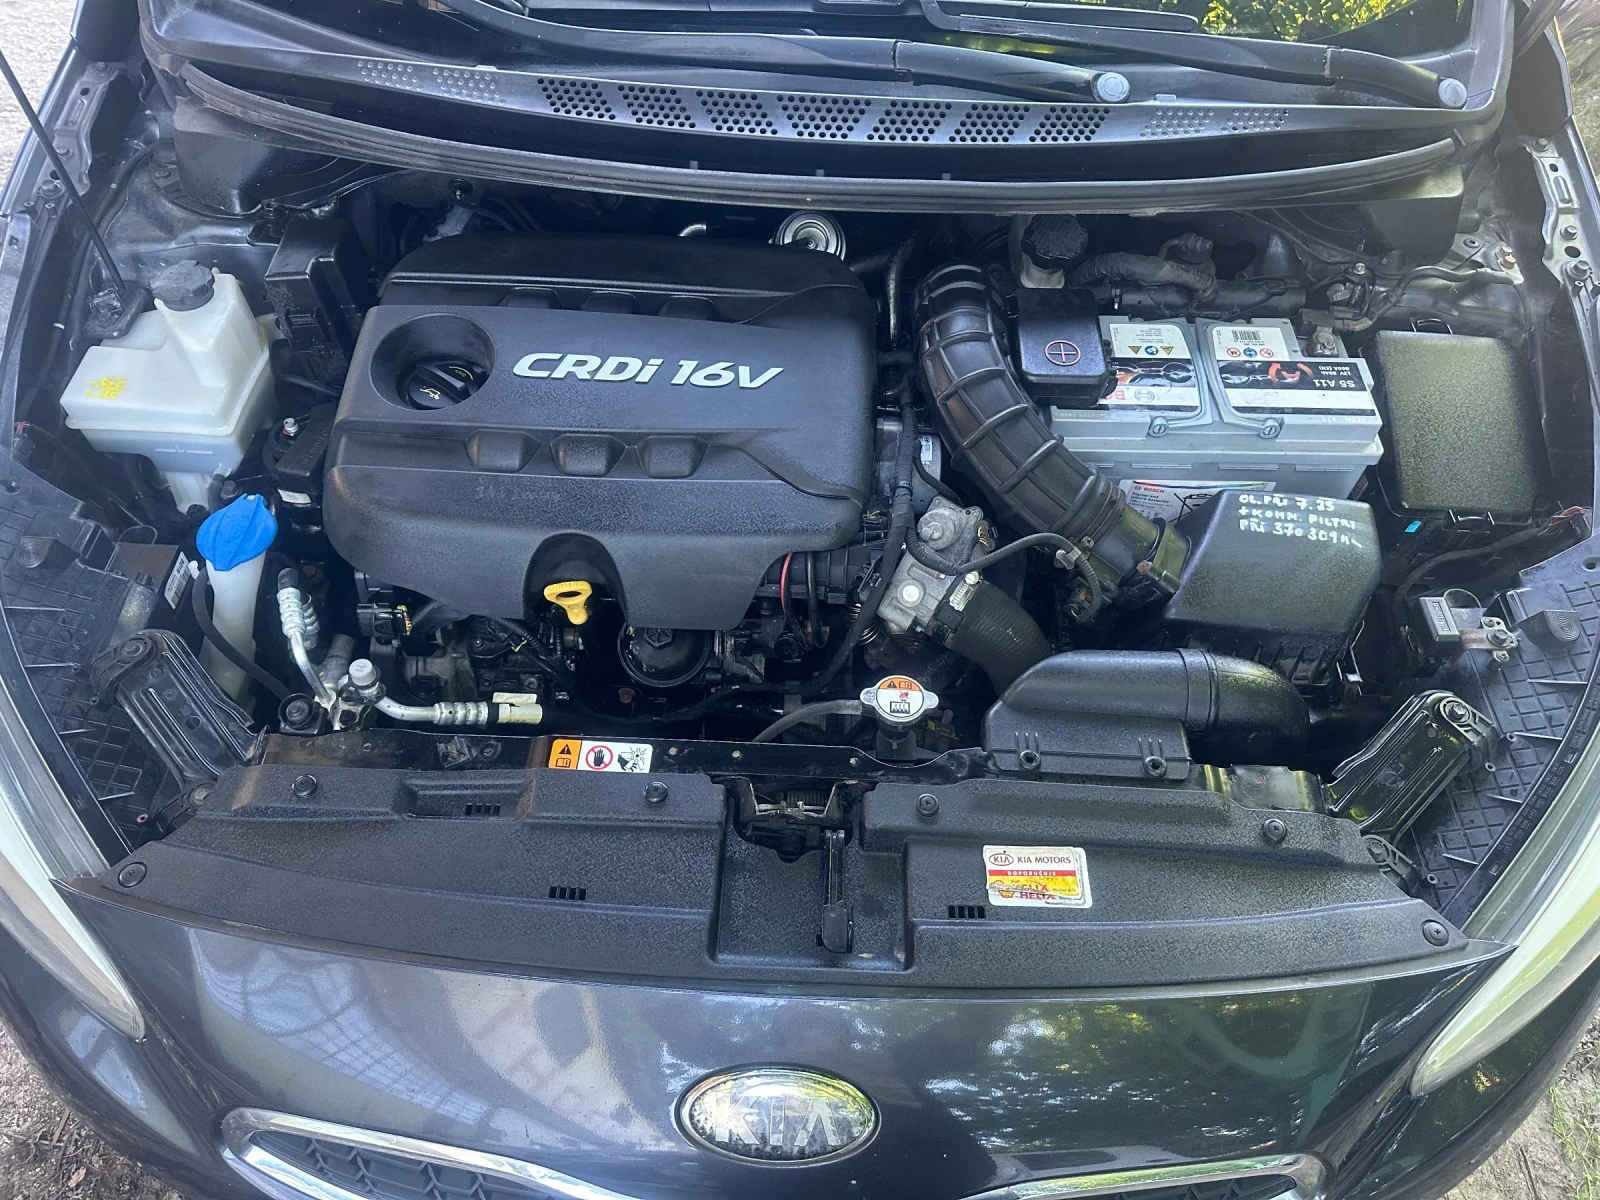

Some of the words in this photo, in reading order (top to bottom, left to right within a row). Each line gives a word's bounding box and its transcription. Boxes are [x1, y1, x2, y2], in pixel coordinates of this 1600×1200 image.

[512, 352, 664, 383] CRDi
[670, 360, 784, 389] 16V
[1312, 379, 1336, 387] A11
[1339, 380, 1356, 388] S5
[715, 1095, 842, 1146] KIA
